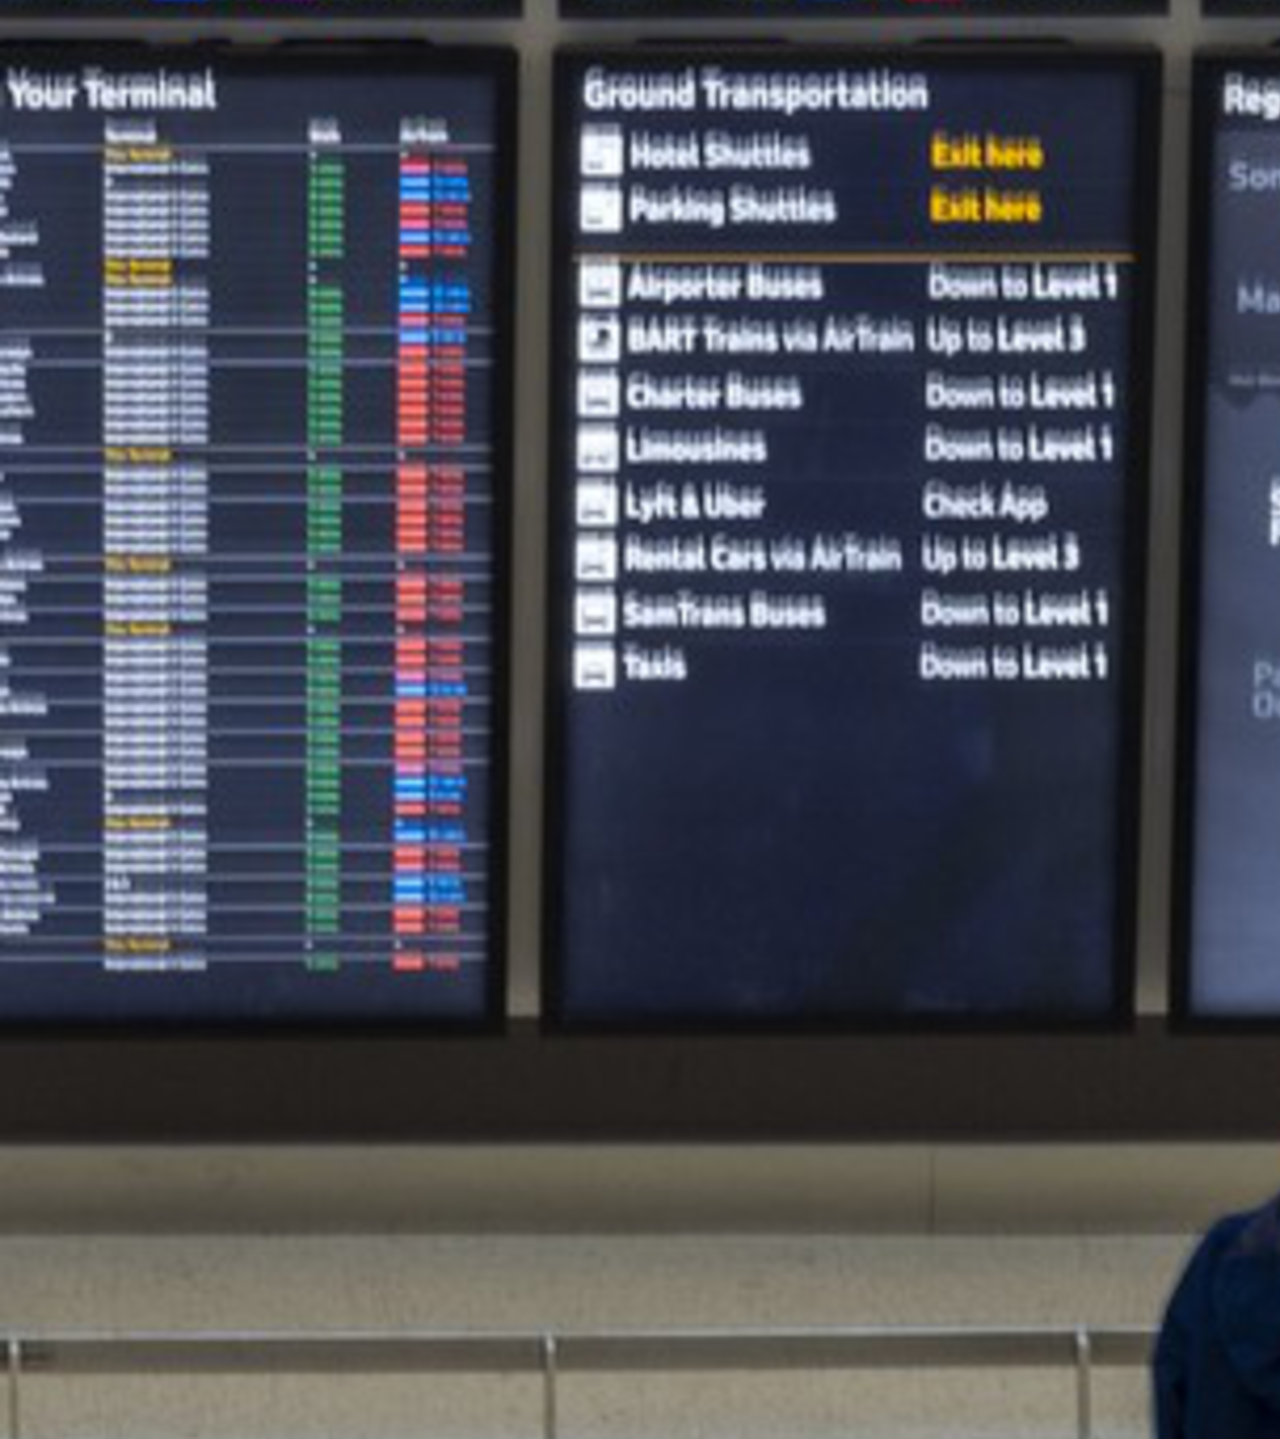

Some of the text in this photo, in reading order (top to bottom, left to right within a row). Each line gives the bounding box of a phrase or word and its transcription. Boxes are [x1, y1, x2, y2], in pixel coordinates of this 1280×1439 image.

[8, 69, 217, 109] Your Terminal
[583, 70, 929, 115] Ground Transportation
[630, 133, 812, 168] Hotel Shuttles
[930, 135, 1043, 167] Exit here
[629, 188, 837, 228] Parking Shuttles
[930, 190, 1042, 222] Exit here
[627, 268, 824, 305] Airporter Buses
[928, 264, 1117, 299] Down to Level 1
[627, 317, 914, 354] BART Trains via AirTrain
[927, 318, 1086, 357] Up to Level 3
[626, 374, 803, 410] Charter Buses
[926, 373, 1115, 410] Down to Level 1
[626, 427, 768, 463] Limousines
[925, 425, 1113, 461] Down to Level 1
[625, 481, 676, 523] Lyft
[704, 483, 767, 519] Uber
[923, 481, 1048, 524] Check App
[624, 534, 902, 572] Rental Cars via AirTrain
[922, 535, 1080, 575] Up to Level 3
[623, 591, 826, 628] SamTrans Buses
[921, 591, 1109, 627] Down to Level 1
[622, 645, 687, 681] Taxis
[920, 644, 1107, 680] Down to Level 1
